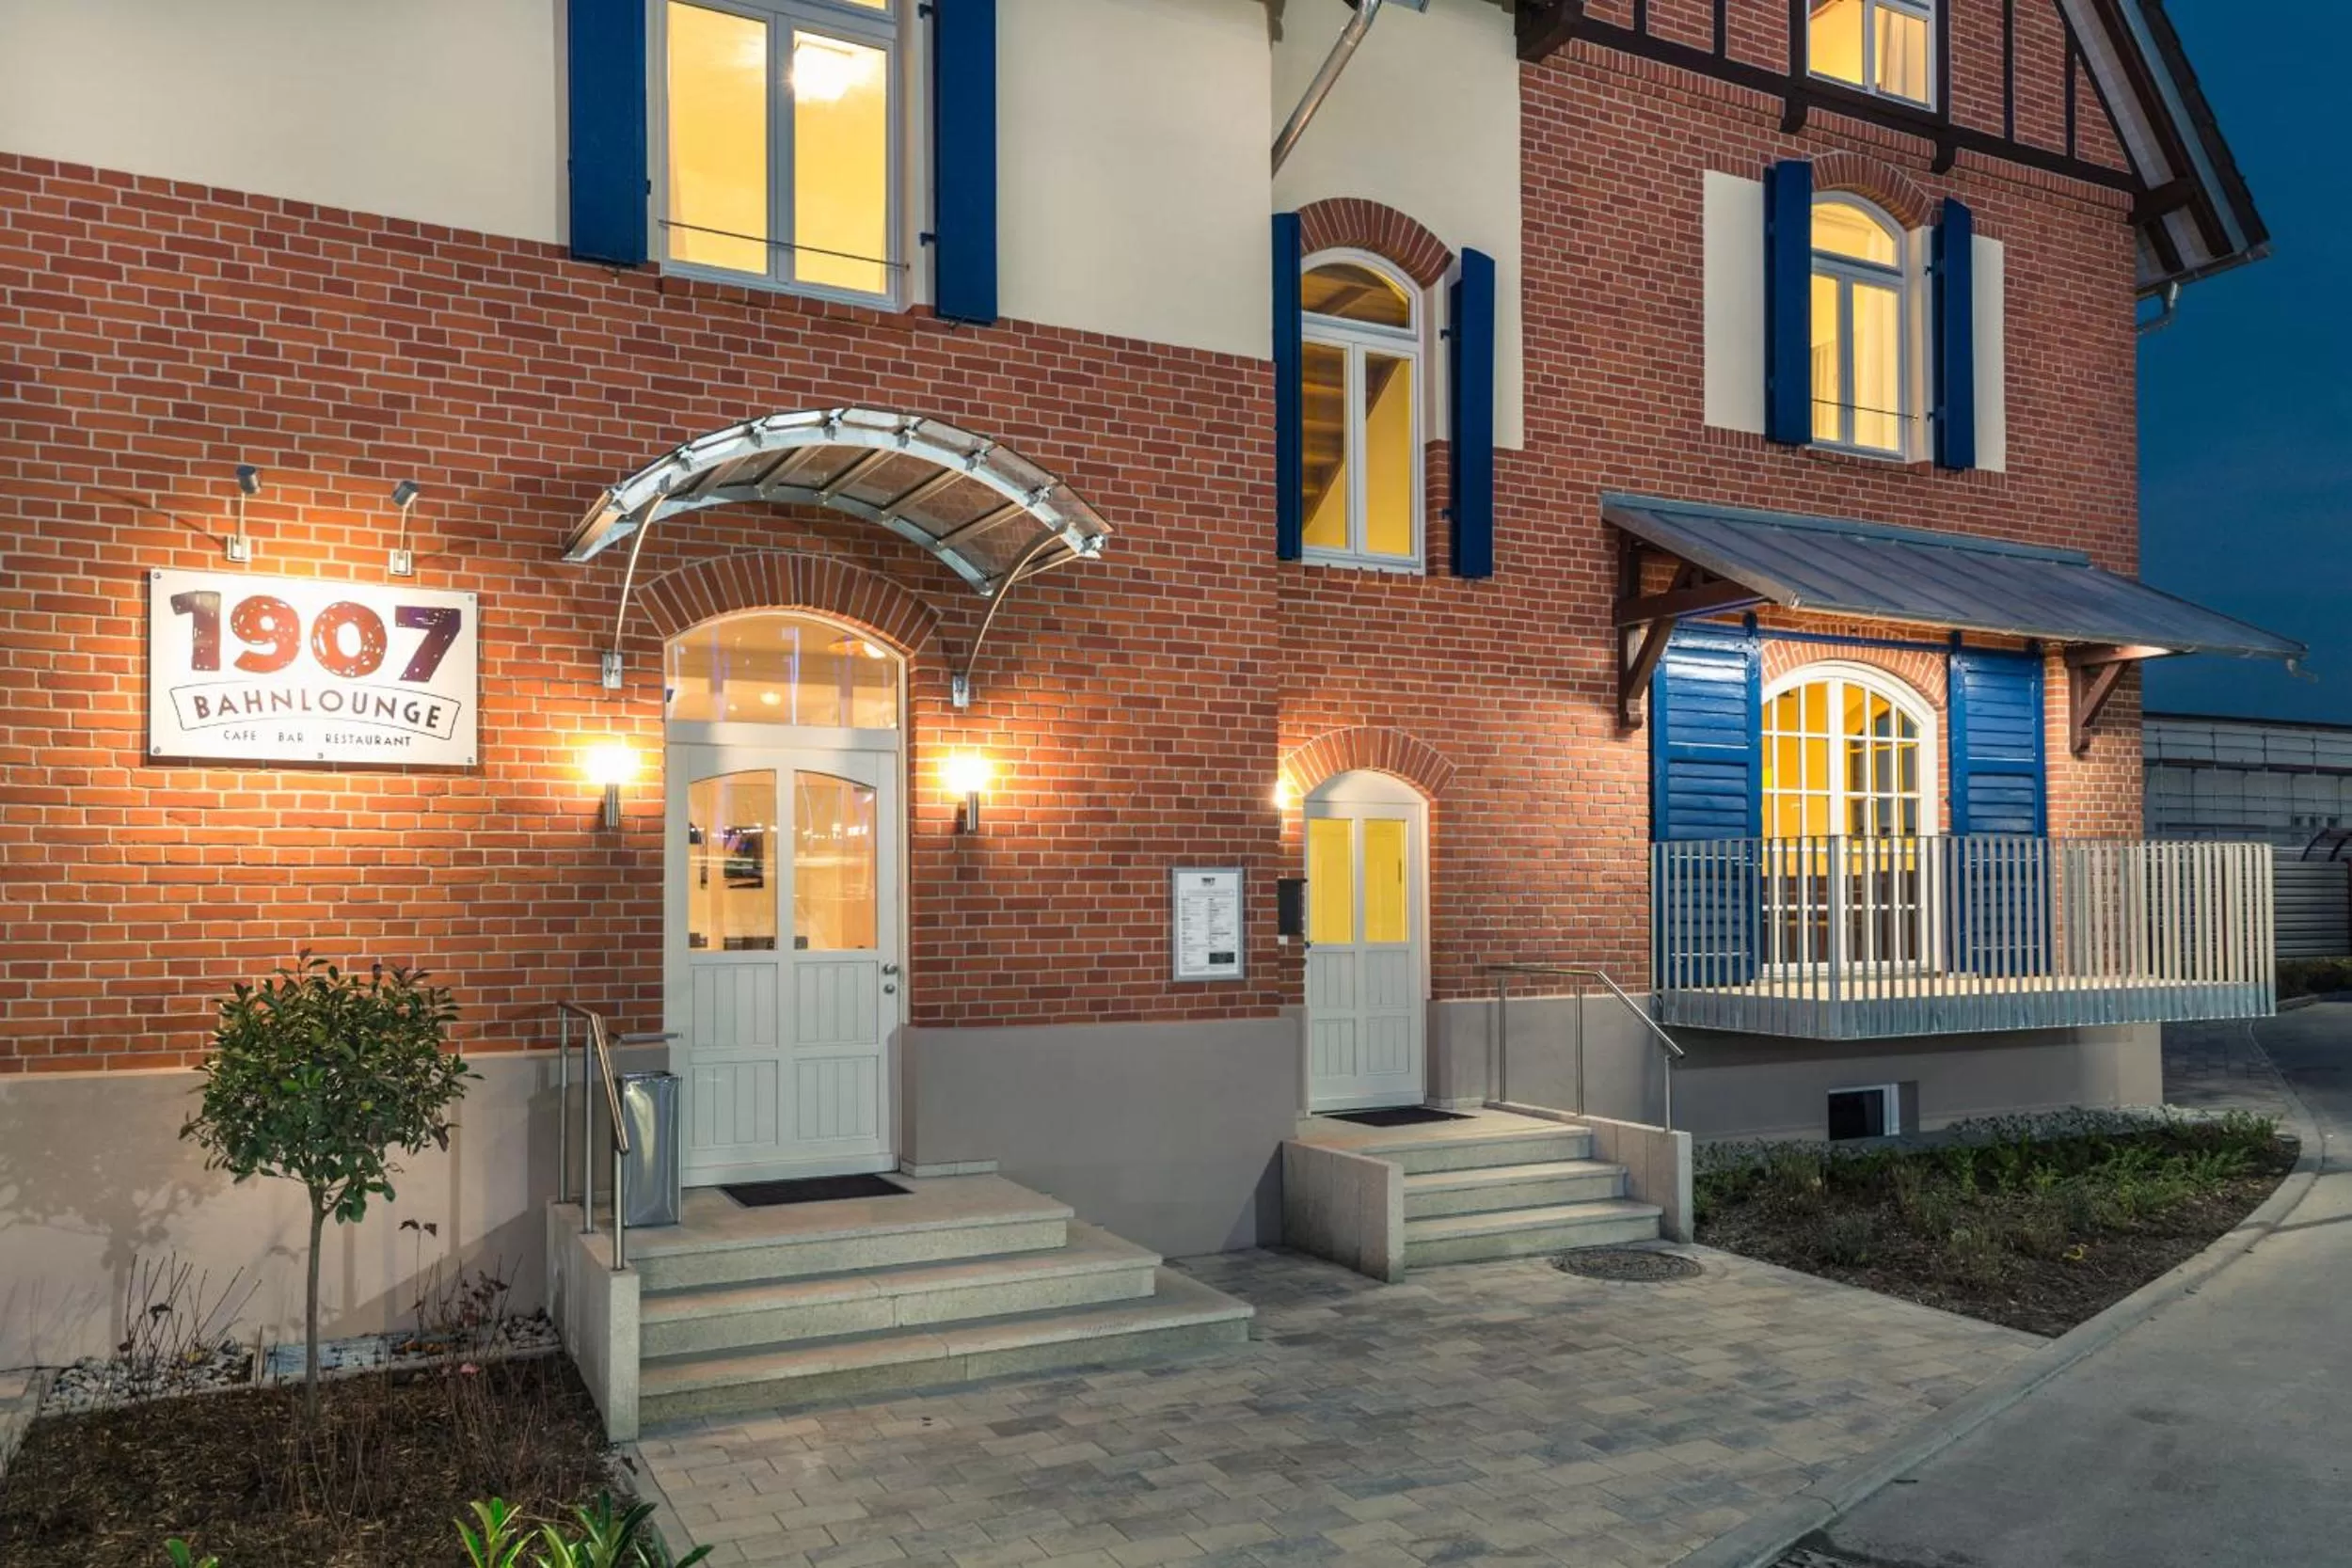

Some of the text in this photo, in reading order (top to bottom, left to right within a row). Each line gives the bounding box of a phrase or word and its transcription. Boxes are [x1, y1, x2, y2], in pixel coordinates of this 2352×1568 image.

[170, 591, 461, 683] 1907
[194, 689, 442, 729] BAHNLOUNGE
[223, 730, 411, 747] CAFE BAR RESTAURANT
